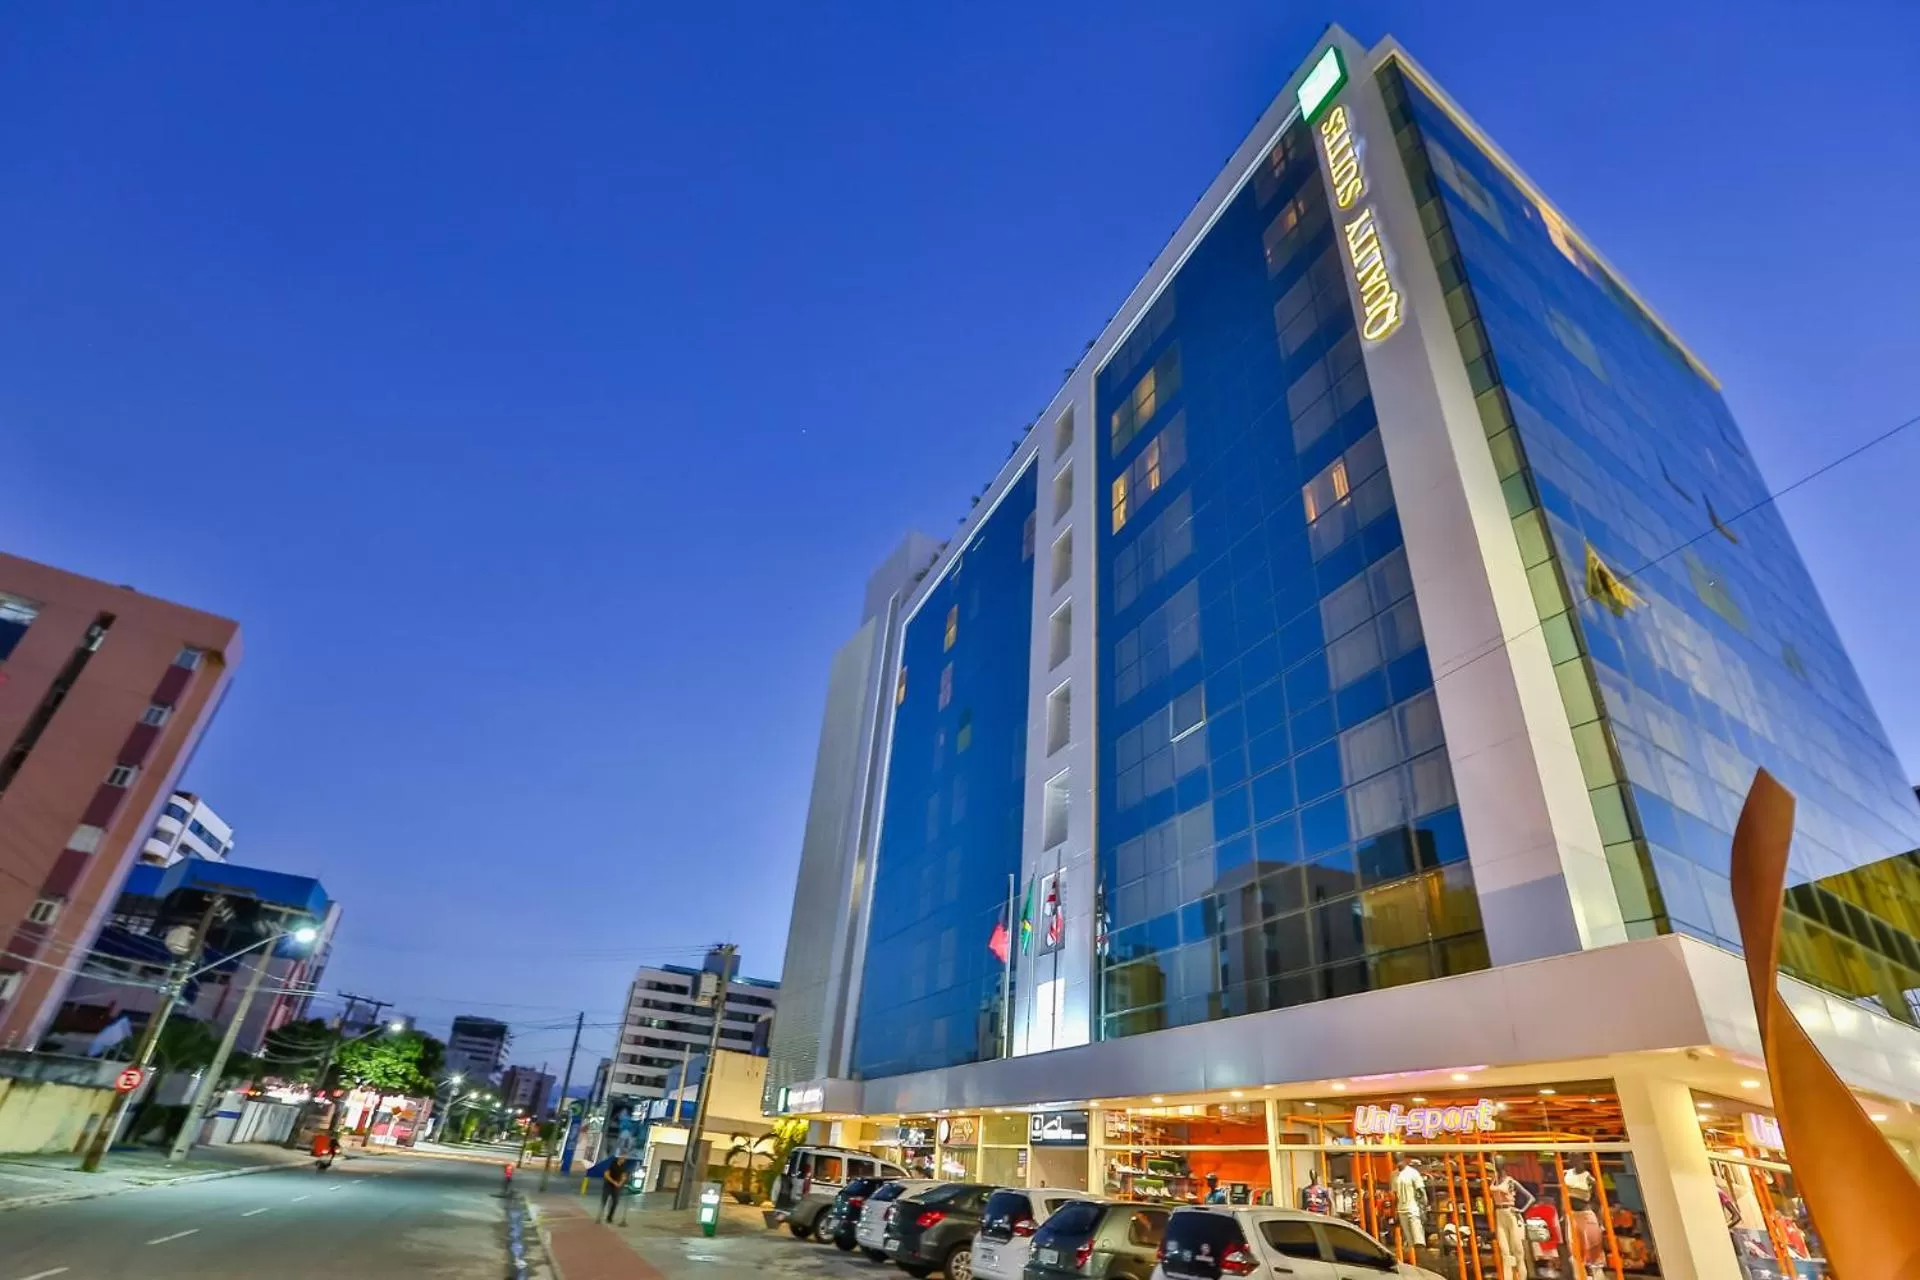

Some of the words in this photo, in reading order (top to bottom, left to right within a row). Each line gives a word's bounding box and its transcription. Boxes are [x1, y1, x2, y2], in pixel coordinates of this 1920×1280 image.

[1321, 105, 1363, 209] SUITES
[1345, 208, 1400, 340] QUALITY
[1354, 1099, 1497, 1139] Uni-sport
